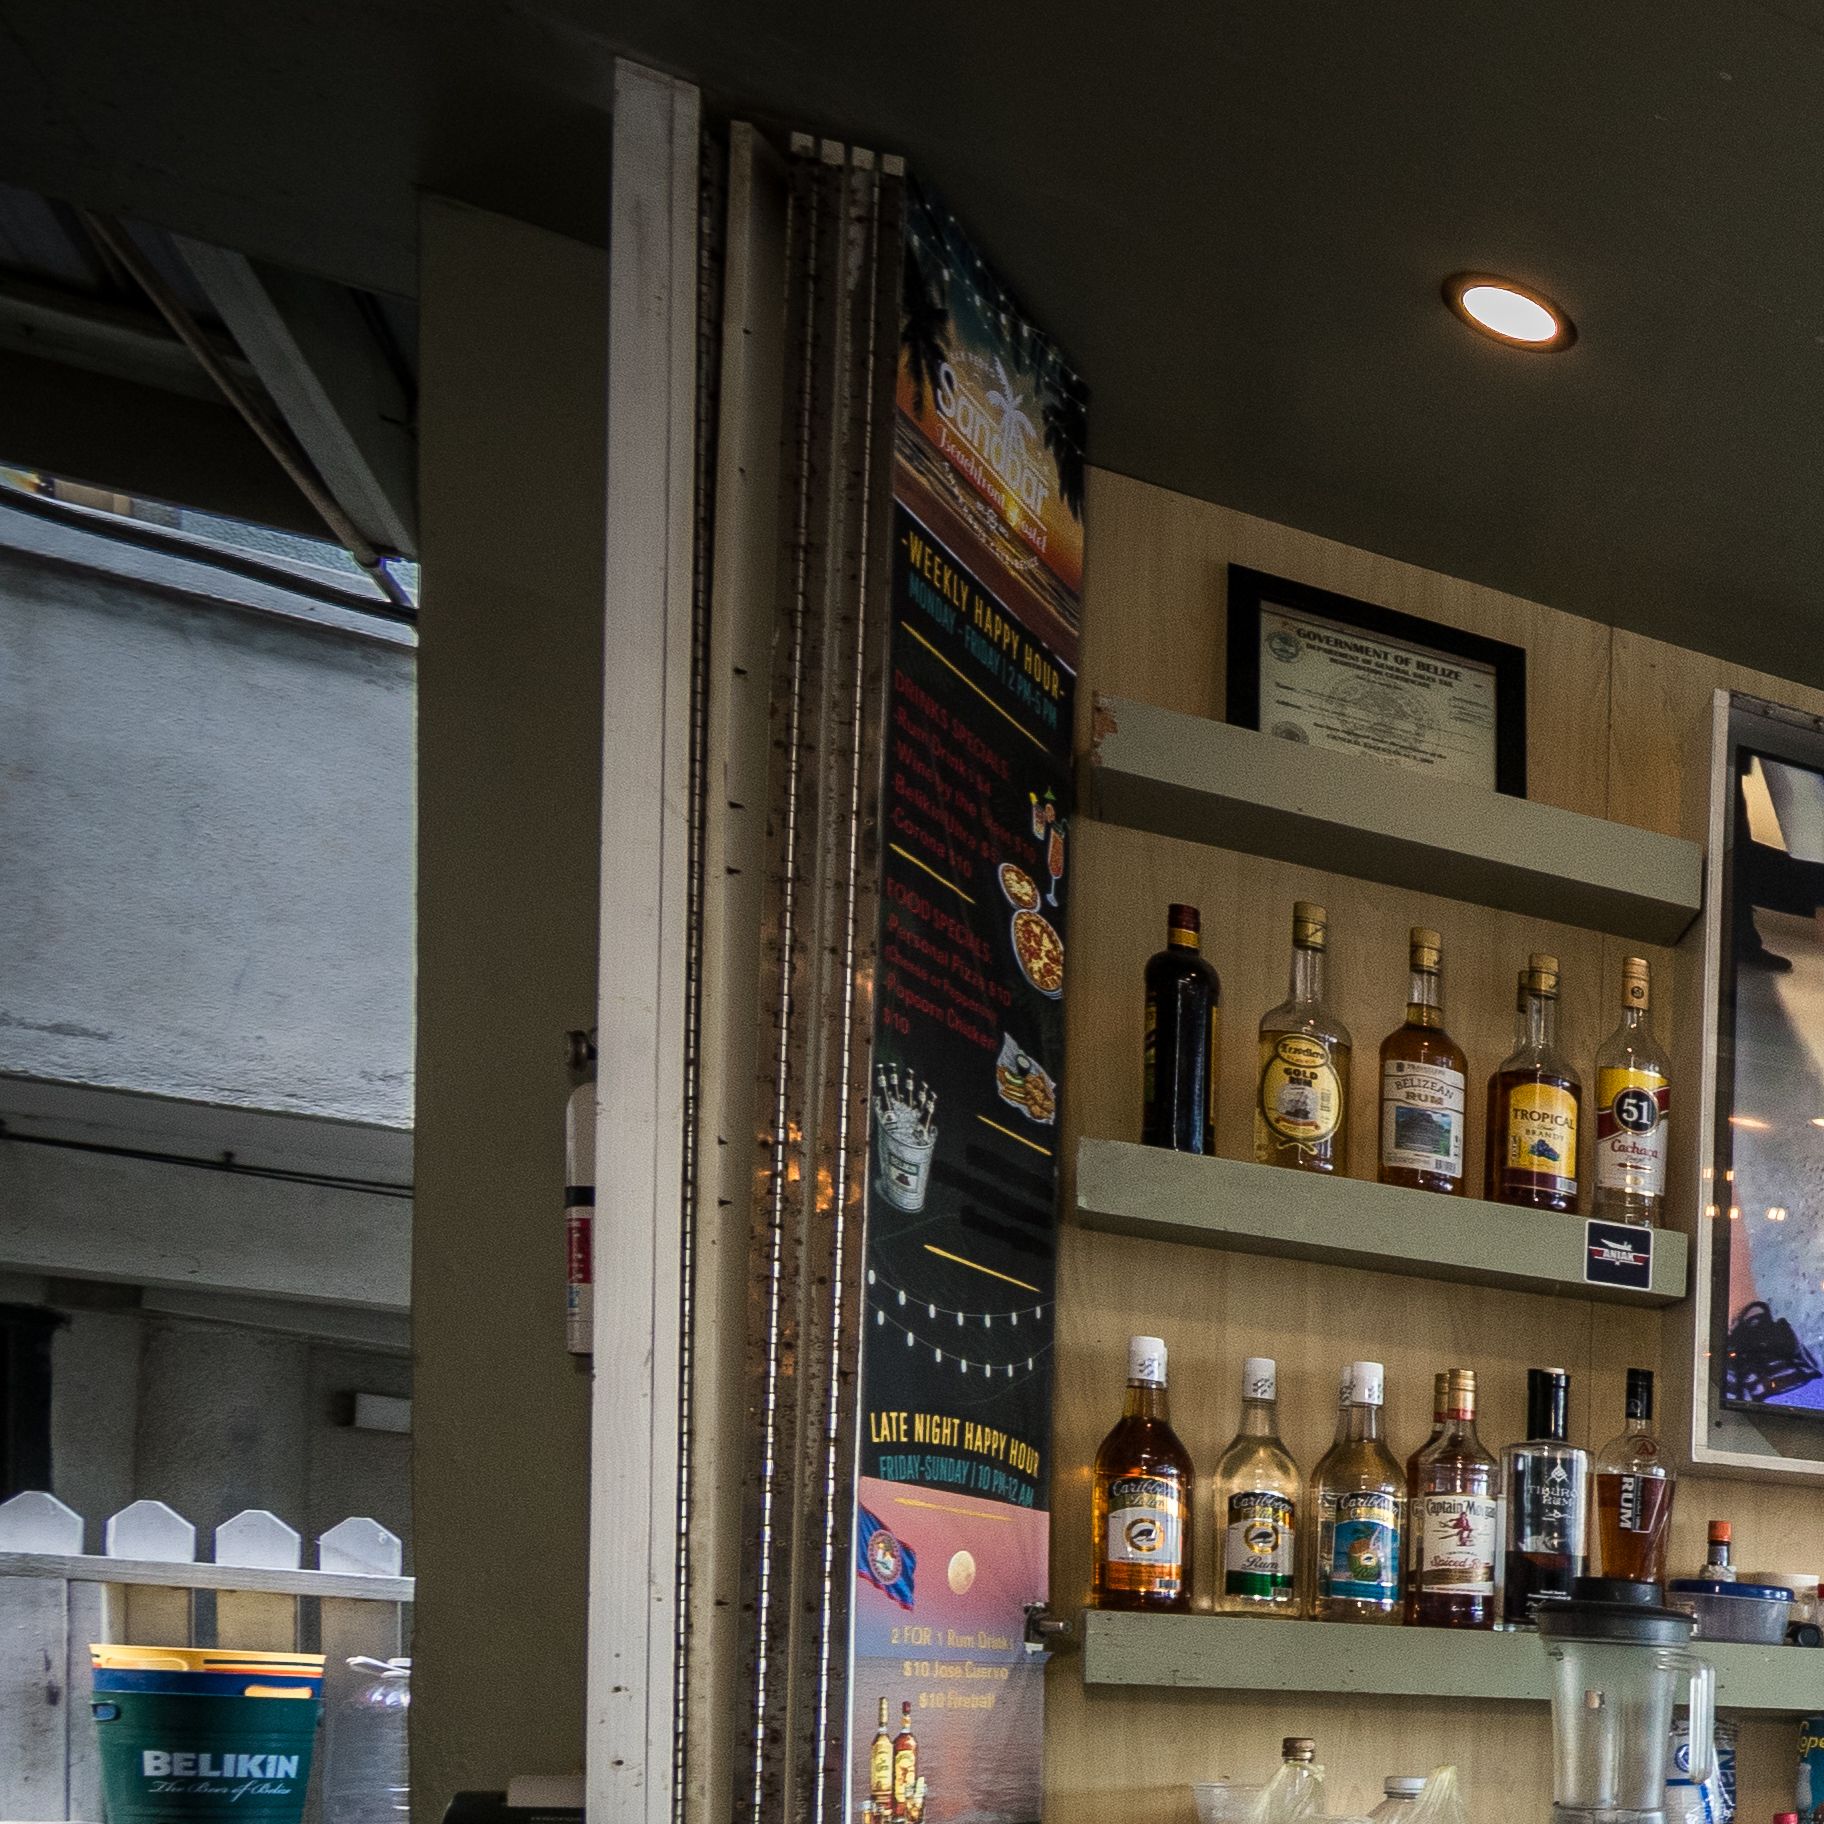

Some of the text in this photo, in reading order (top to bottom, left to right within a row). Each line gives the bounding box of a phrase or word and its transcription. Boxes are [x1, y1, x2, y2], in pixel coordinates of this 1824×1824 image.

[936, 361, 1048, 516] Sandbar
[909, 575, 955, 636] MONDAY
[964, 623, 999, 675] FRIDAY
[974, 594, 1020, 660] HAPPY
[1297, 627, 1463, 682] GOVERNMENT OF BELIZE
[886, 877, 930, 920] FOOD
[1283, 1066, 1319, 1081] GOLD
[1395, 1076, 1456, 1100] BELIZEAN
[1404, 1089, 1446, 1105] RUM
[1513, 1107, 1576, 1130] TROPICAL
[1622, 1098, 1652, 1125] 51
[1525, 1128, 1565, 1143] BRANDY
[870, 1411, 1041, 1479] LATE NIGHT HAPPY HOUR
[978, 1464, 990, 1491] 10
[1018, 1482, 1035, 1508] AM
[1426, 1499, 1463, 1515] Captain
[1619, 1476, 1635, 1530] RUM
[890, 1628, 899, 1645] 2
[904, 1626, 932, 1646] FOR
[902, 1660, 929, 1678] $10
[143, 1750, 299, 1779] BELIKIN
[148, 1779, 293, 1803] The Beer of Belize
